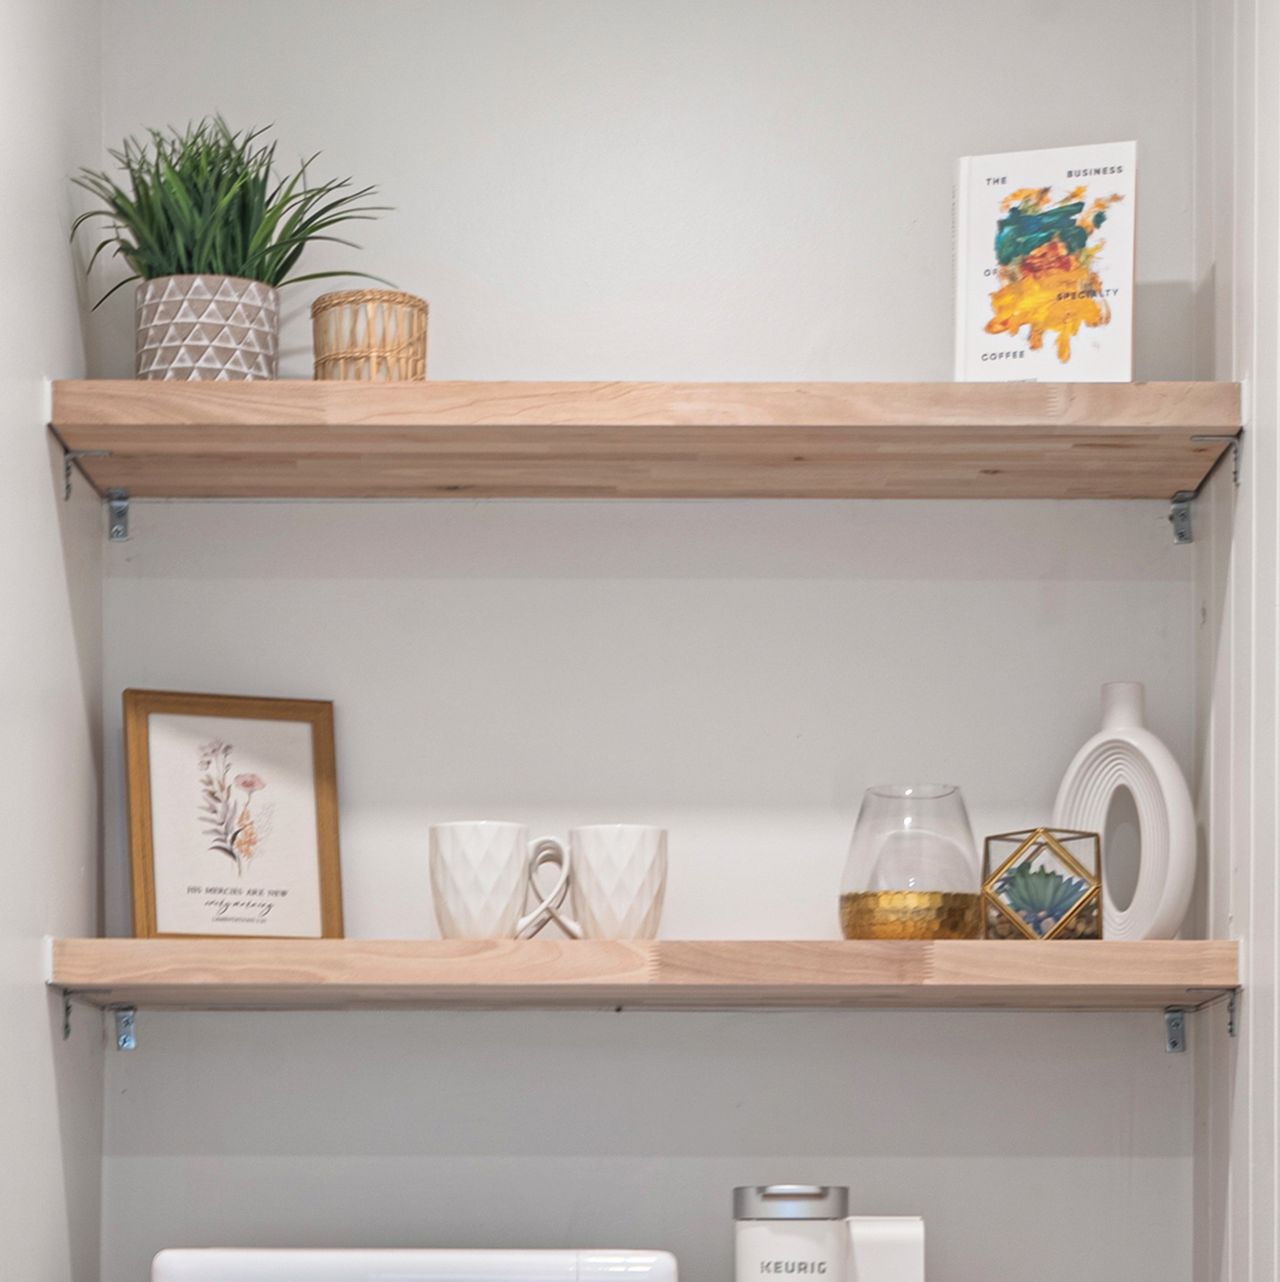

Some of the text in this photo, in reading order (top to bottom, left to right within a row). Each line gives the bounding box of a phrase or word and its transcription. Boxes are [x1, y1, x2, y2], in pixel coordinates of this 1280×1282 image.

[1066, 165, 1124, 179] BUSINESS
[986, 176, 1008, 186] THE
[983, 268, 998, 278] OF
[1056, 288, 1119, 301] SPECIALTY
[980, 350, 1025, 361] COFFEE
[760, 1261, 828, 1274] KEURIG
